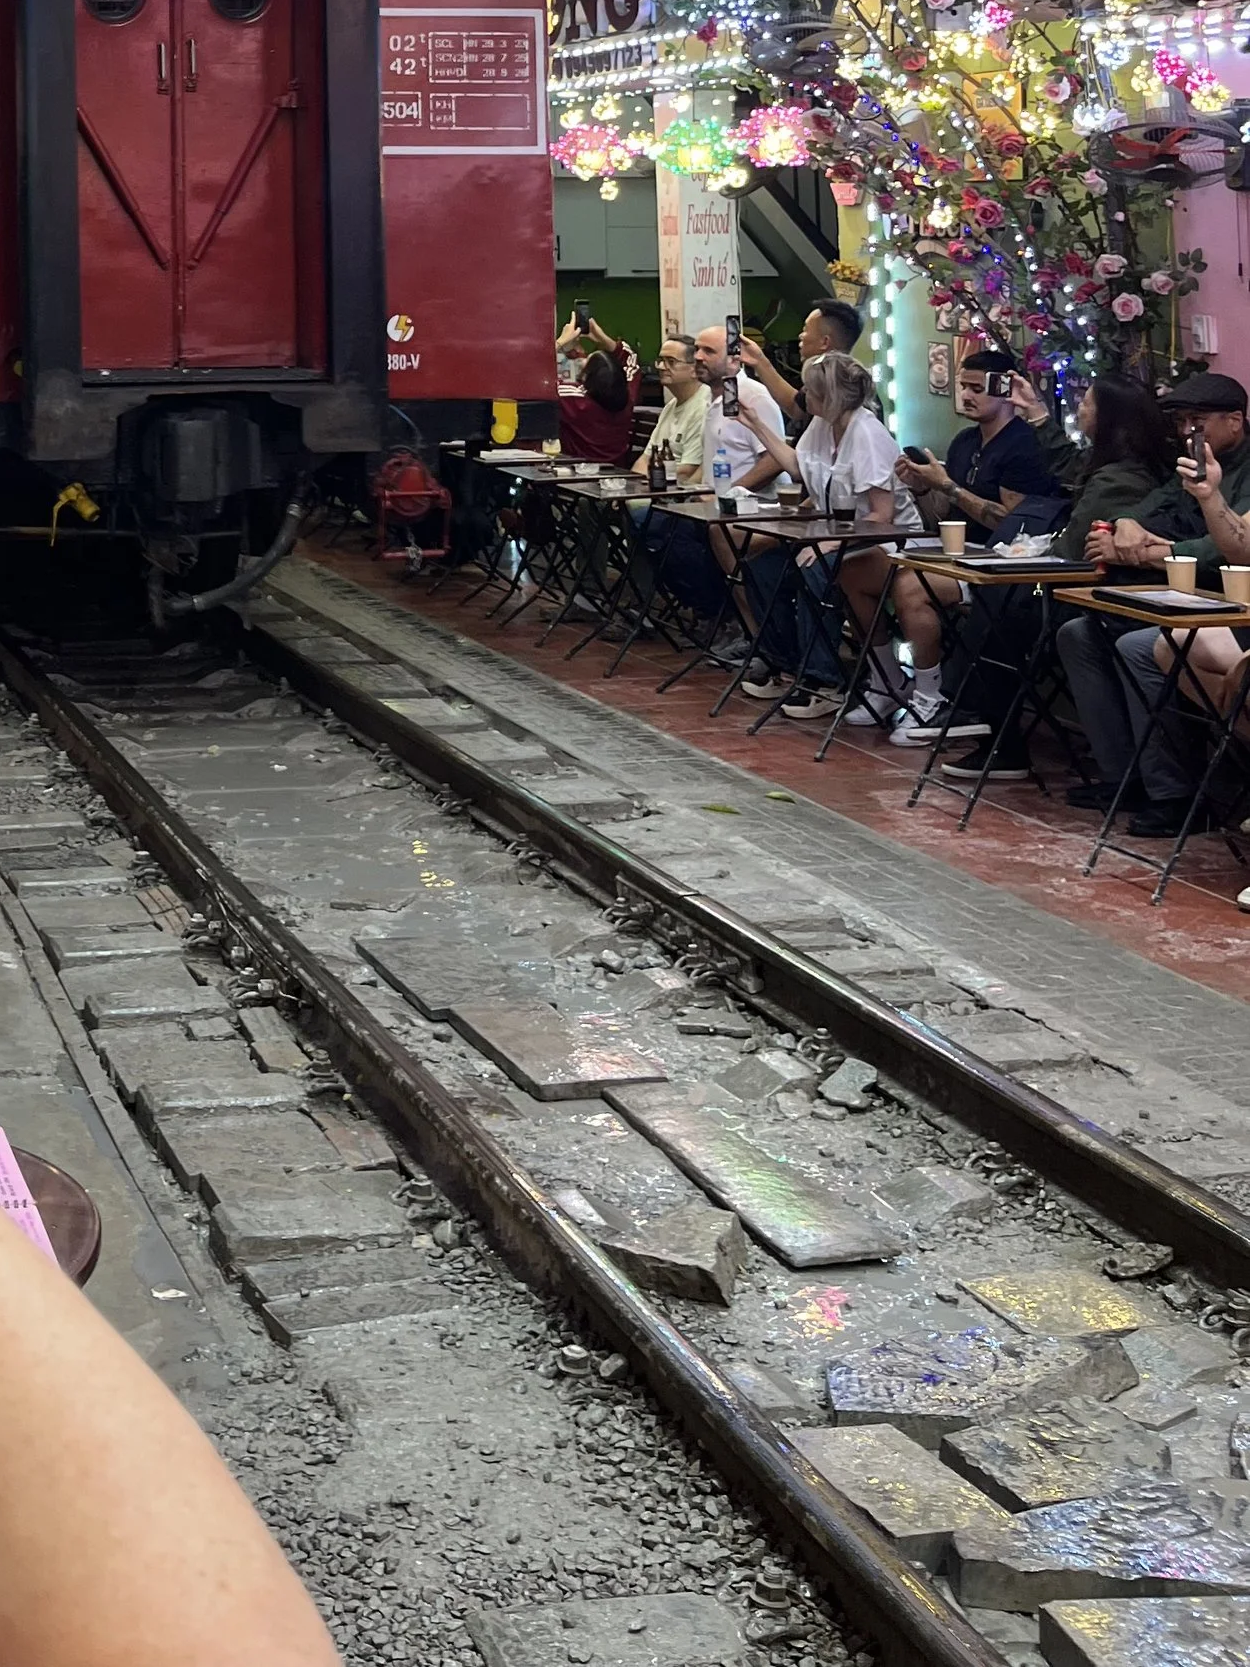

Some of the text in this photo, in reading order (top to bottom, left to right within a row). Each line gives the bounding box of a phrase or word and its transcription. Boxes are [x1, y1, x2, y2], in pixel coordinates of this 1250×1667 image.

[500, 53, 507, 63] 7
[381, 101, 419, 120] 504
[685, 201, 731, 245] Fastfood
[691, 255, 715, 288] Sinh
[716, 250, 729, 288] tố
